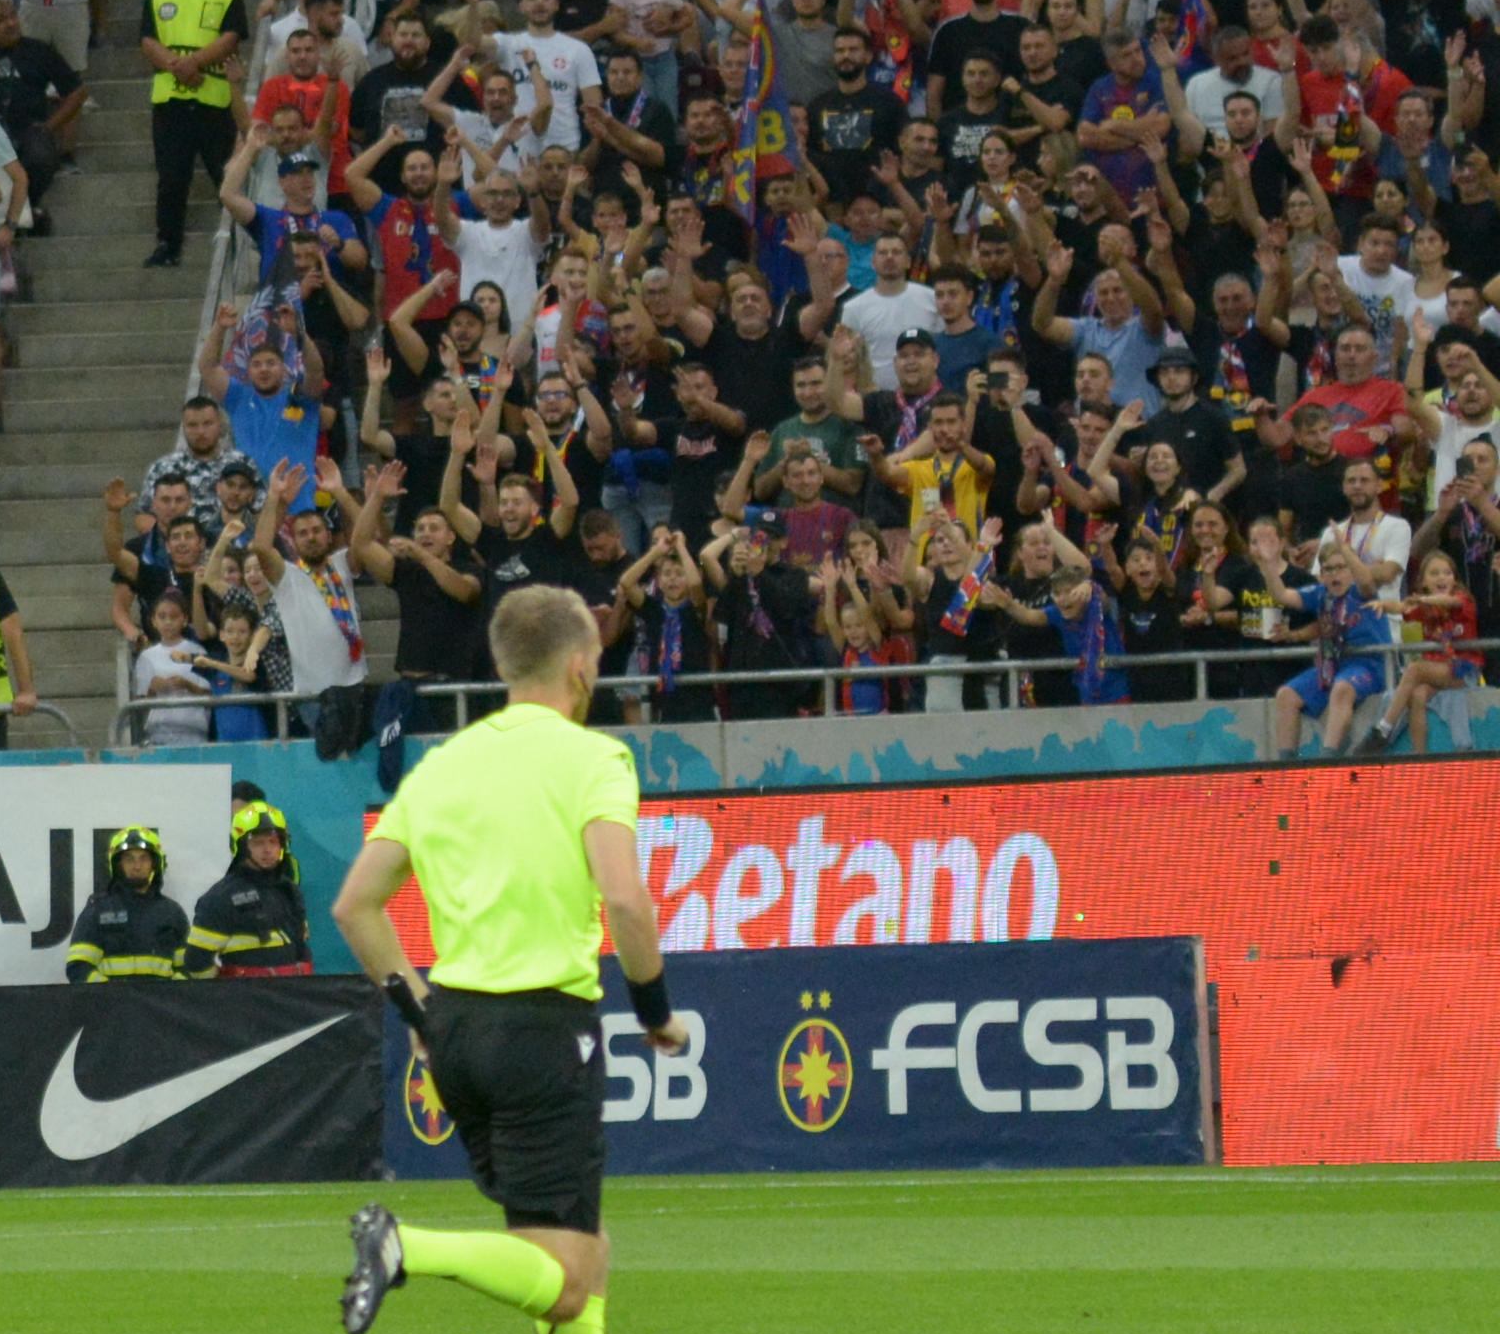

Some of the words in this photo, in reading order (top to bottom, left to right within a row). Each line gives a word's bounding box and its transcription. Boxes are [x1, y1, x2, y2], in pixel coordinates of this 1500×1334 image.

[632, 813, 1060, 953] Betano
[601, 1010, 708, 1123] SB
[871, 996, 1180, 1116] FCSB
